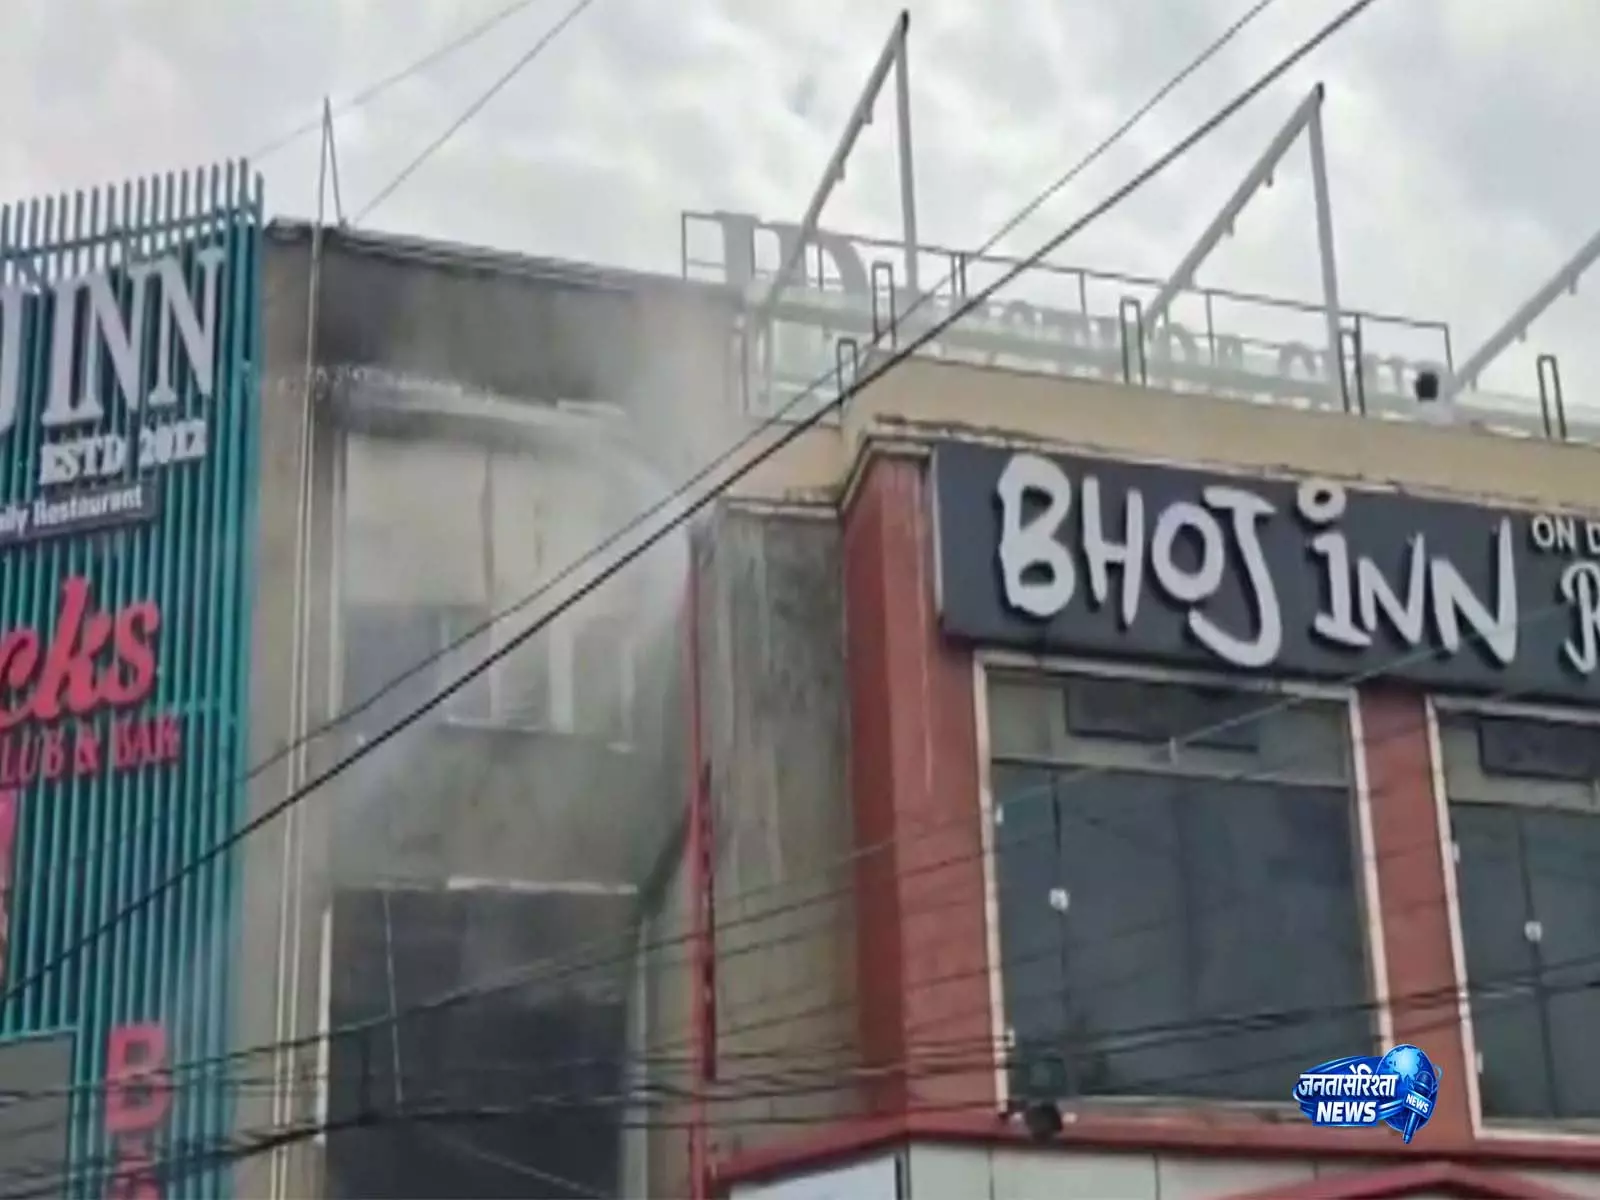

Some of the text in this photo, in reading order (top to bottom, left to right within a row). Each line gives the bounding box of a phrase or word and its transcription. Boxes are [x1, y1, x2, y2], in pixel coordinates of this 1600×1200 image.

[41, 245, 225, 427] INN
[39, 433, 126, 485] ESTD
[1532, 514, 1576, 550] ON
[997, 453, 1283, 668] BHOJ
[114, 714, 180, 767] BAR
